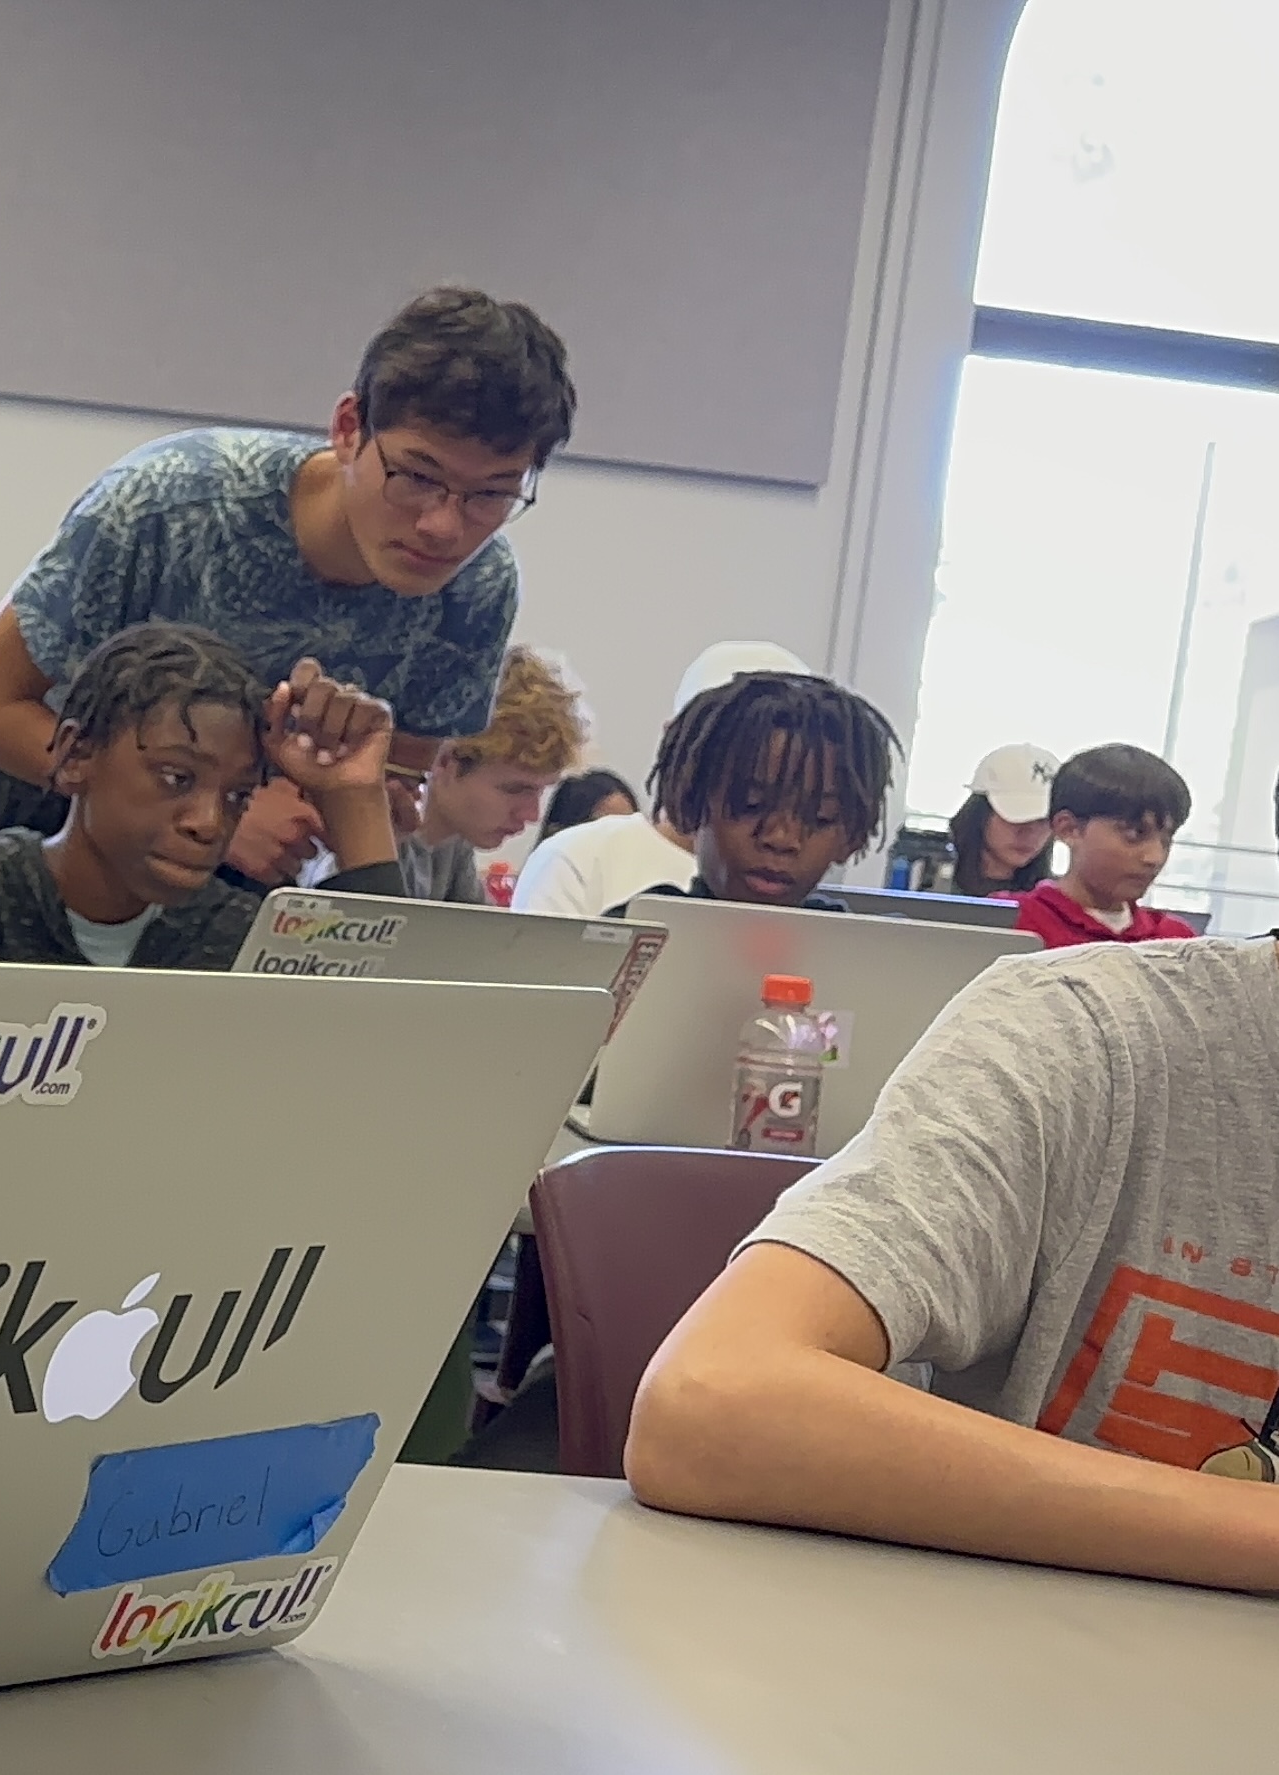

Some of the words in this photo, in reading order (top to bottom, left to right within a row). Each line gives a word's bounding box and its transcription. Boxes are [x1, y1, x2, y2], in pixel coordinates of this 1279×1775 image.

[35, 1083, 71, 1095] .com
[769, 1082, 803, 1118] G
[97, 1466, 270, 1557] Gabriel
[100, 1564, 324, 1656] logikcull
